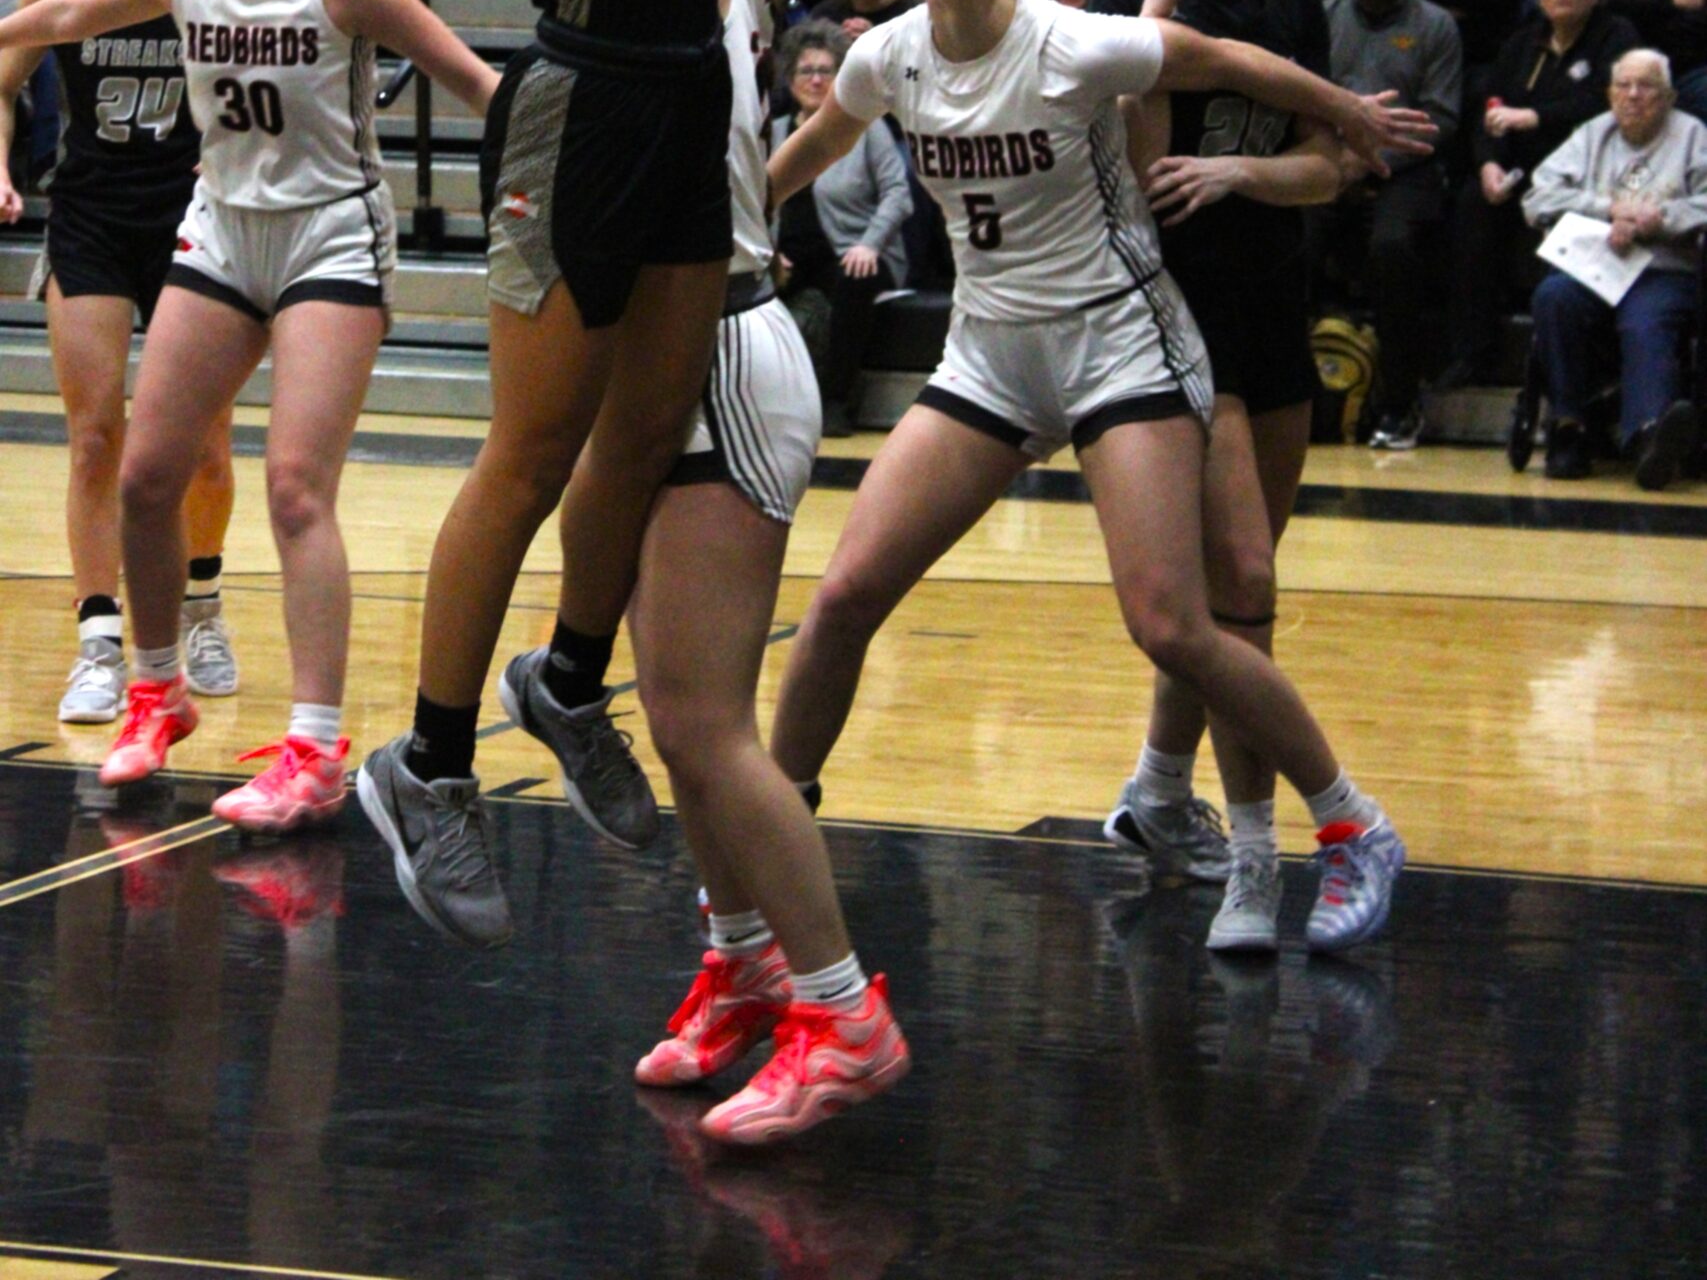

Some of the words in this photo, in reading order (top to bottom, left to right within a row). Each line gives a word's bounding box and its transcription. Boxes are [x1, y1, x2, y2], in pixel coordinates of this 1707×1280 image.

[96, 77, 186, 143] 24
[214, 77, 285, 137] 30
[962, 193, 1002, 251] 5
